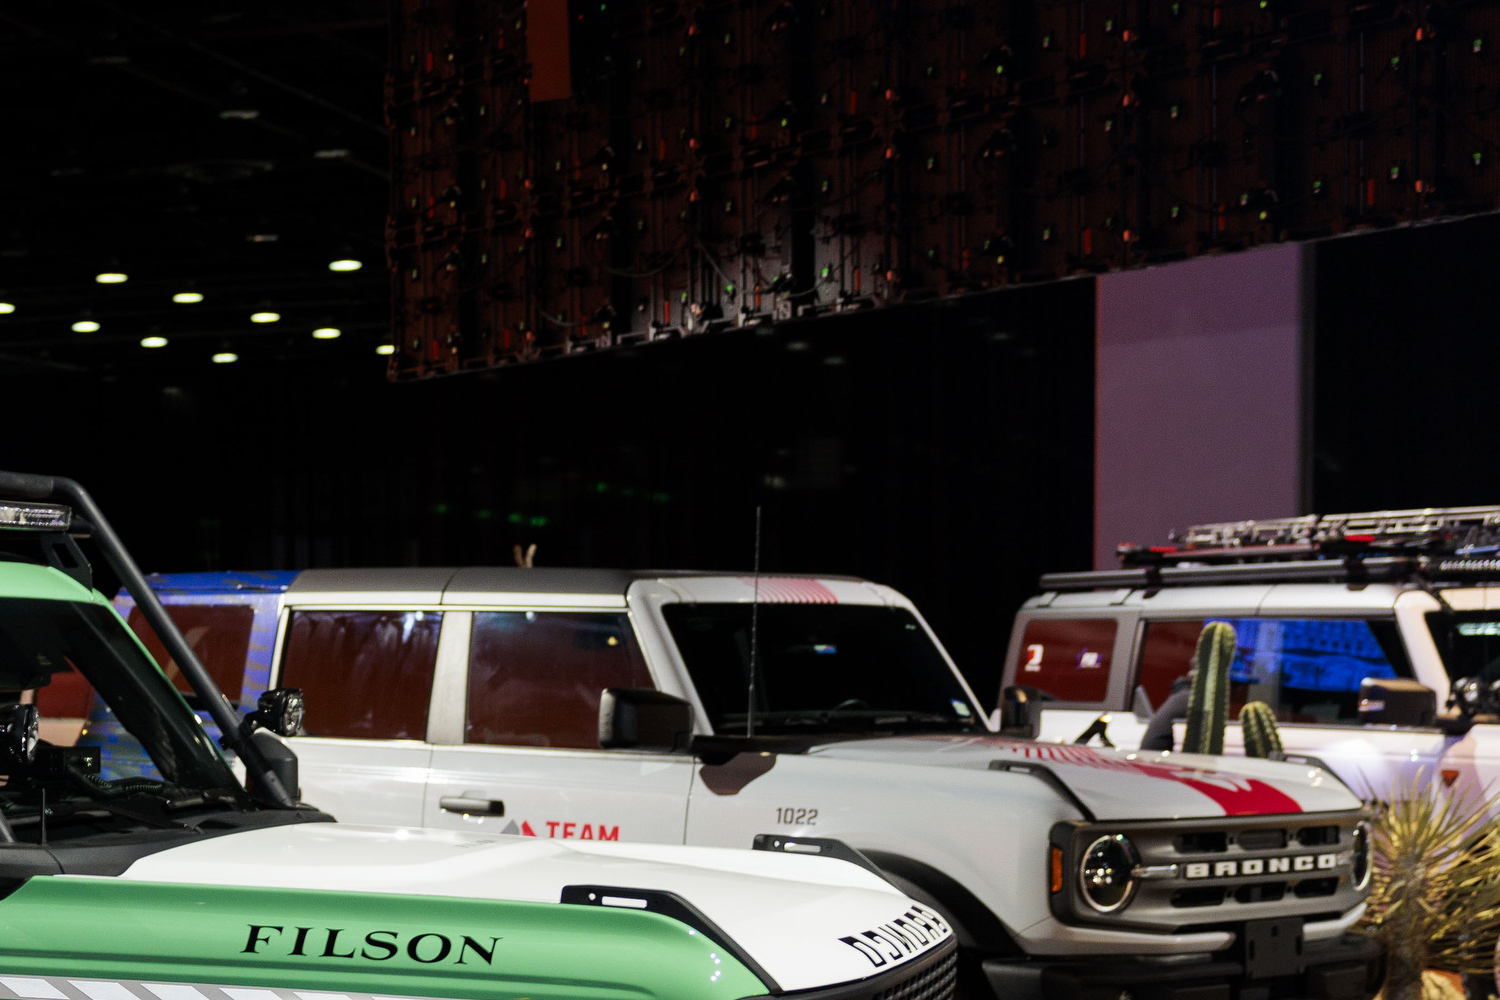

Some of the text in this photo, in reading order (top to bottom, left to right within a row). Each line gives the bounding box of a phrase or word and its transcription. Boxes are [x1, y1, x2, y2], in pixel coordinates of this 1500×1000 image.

[775, 807, 819, 826] 1022
[546, 821, 620, 842] TEAM
[1185, 853, 1337, 879] BRONCO
[239, 923, 504, 967] FILSON
